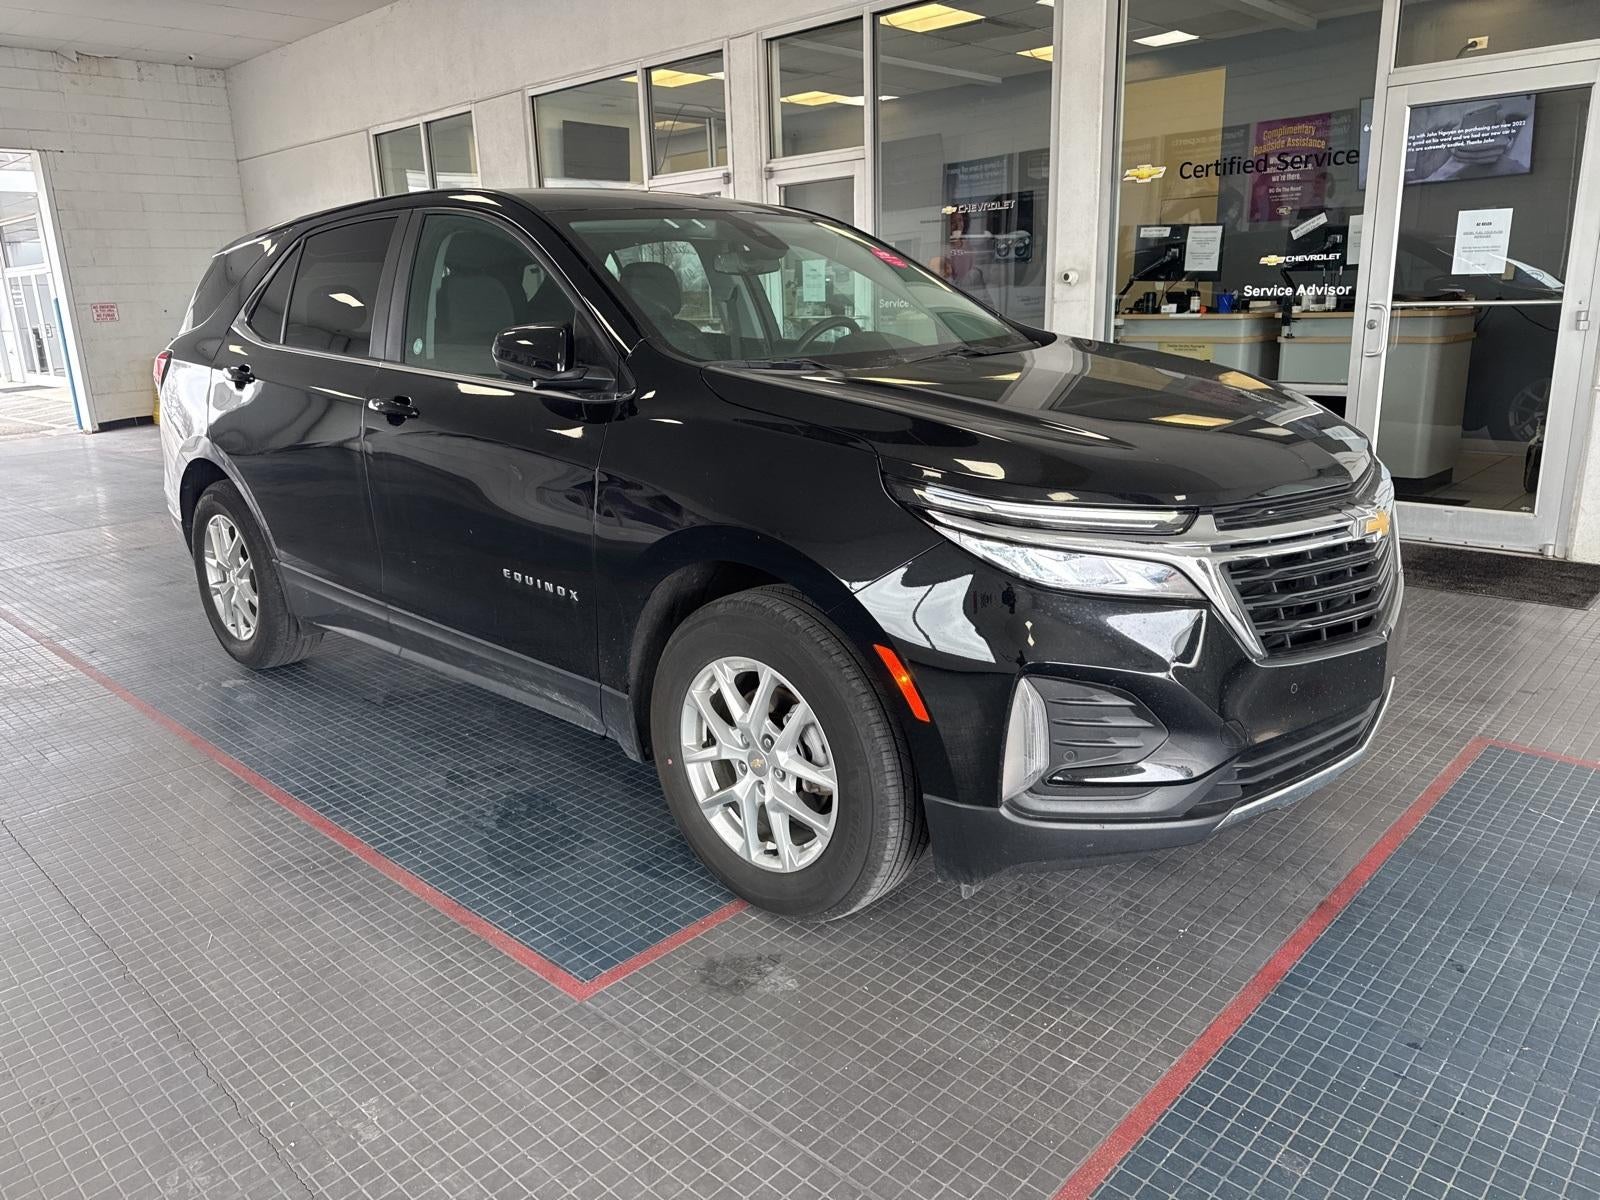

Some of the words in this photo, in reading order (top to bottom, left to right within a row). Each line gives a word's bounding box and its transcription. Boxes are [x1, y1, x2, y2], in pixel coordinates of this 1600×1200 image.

[1263, 123, 1317, 140] Complimentary
[1286, 137, 1327, 150] Assistance
[1179, 153, 1269, 180] Certified
[1276, 146, 1359, 172] Service
[957, 200, 1016, 214] CHEVROLET
[1285, 252, 1341, 263] CHEVROLET
[1243, 285, 1293, 297] Service
[1296, 283, 1352, 296] Advisor
[502, 568, 579, 602] EQUINOX
